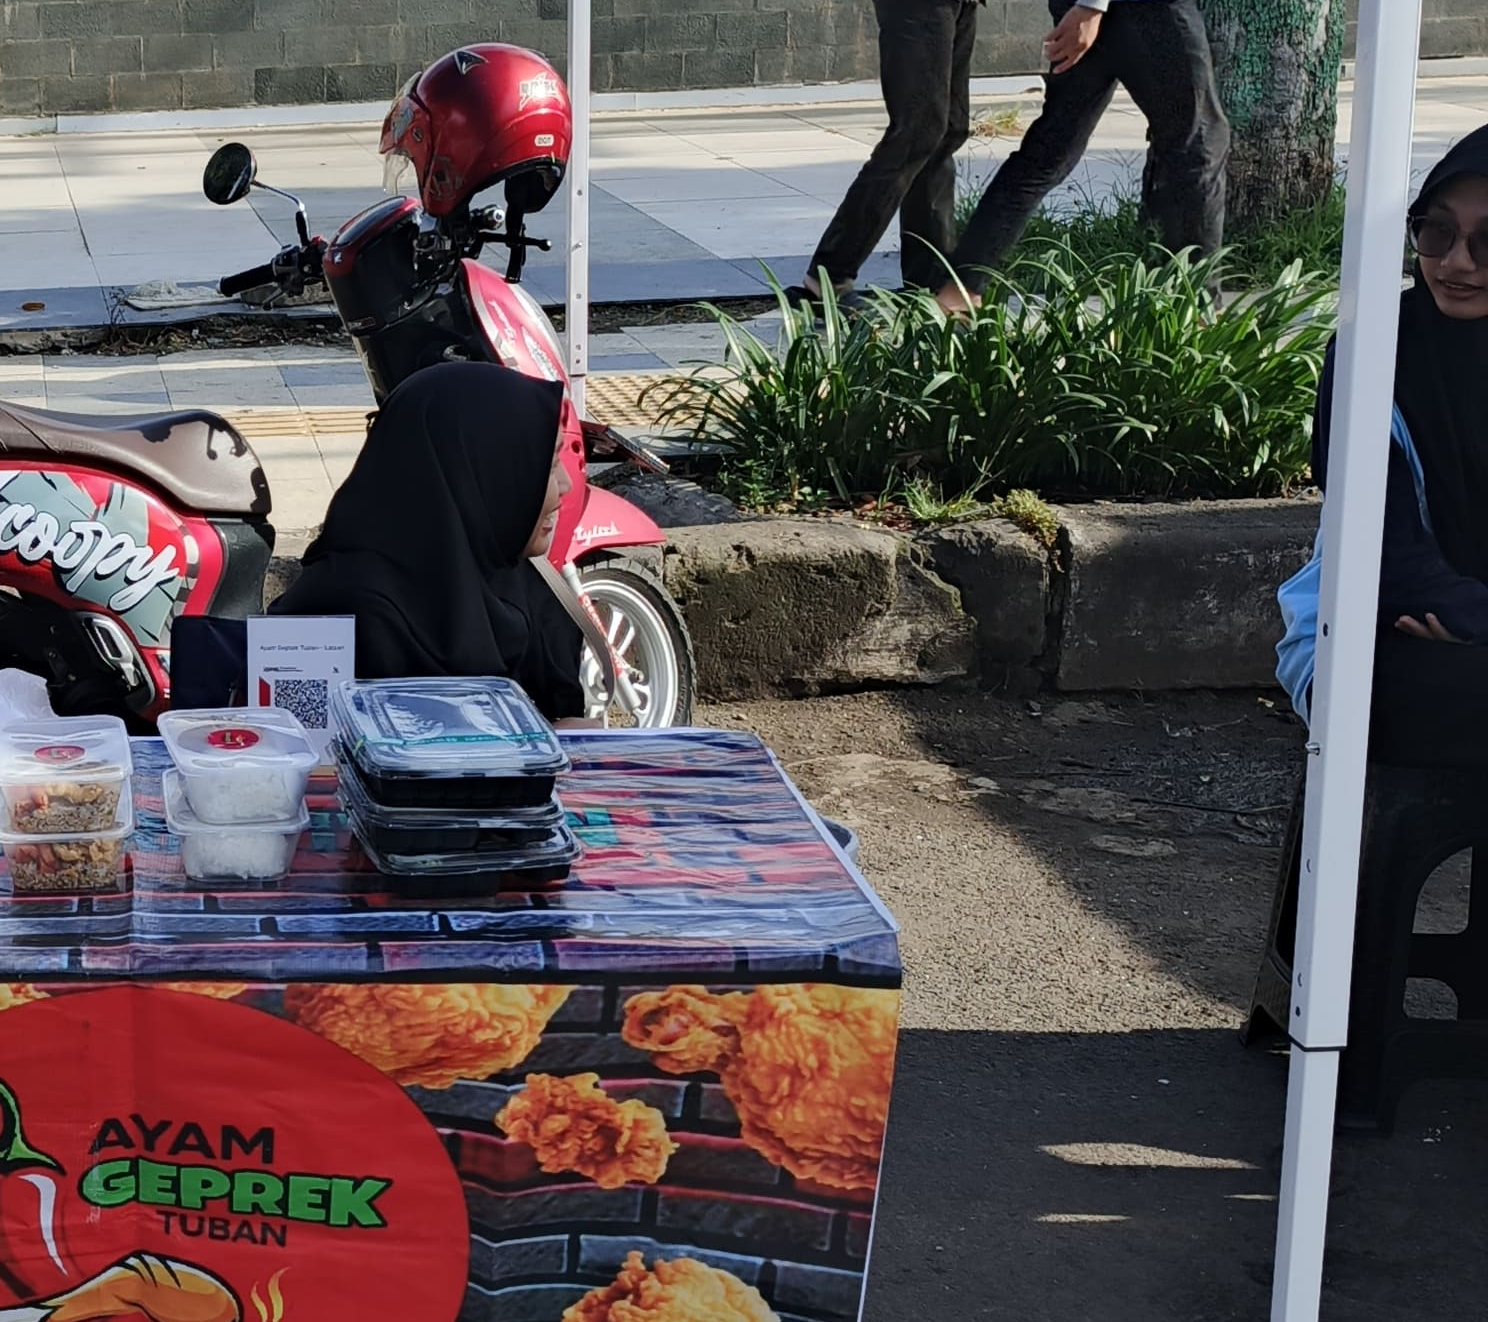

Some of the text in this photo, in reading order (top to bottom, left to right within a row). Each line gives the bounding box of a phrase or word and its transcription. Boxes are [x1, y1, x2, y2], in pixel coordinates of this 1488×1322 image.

[88, 1114, 275, 1165] AYAM
[79, 1155, 393, 1228] GEPREK
[155, 1209, 288, 1247] TUBAN
